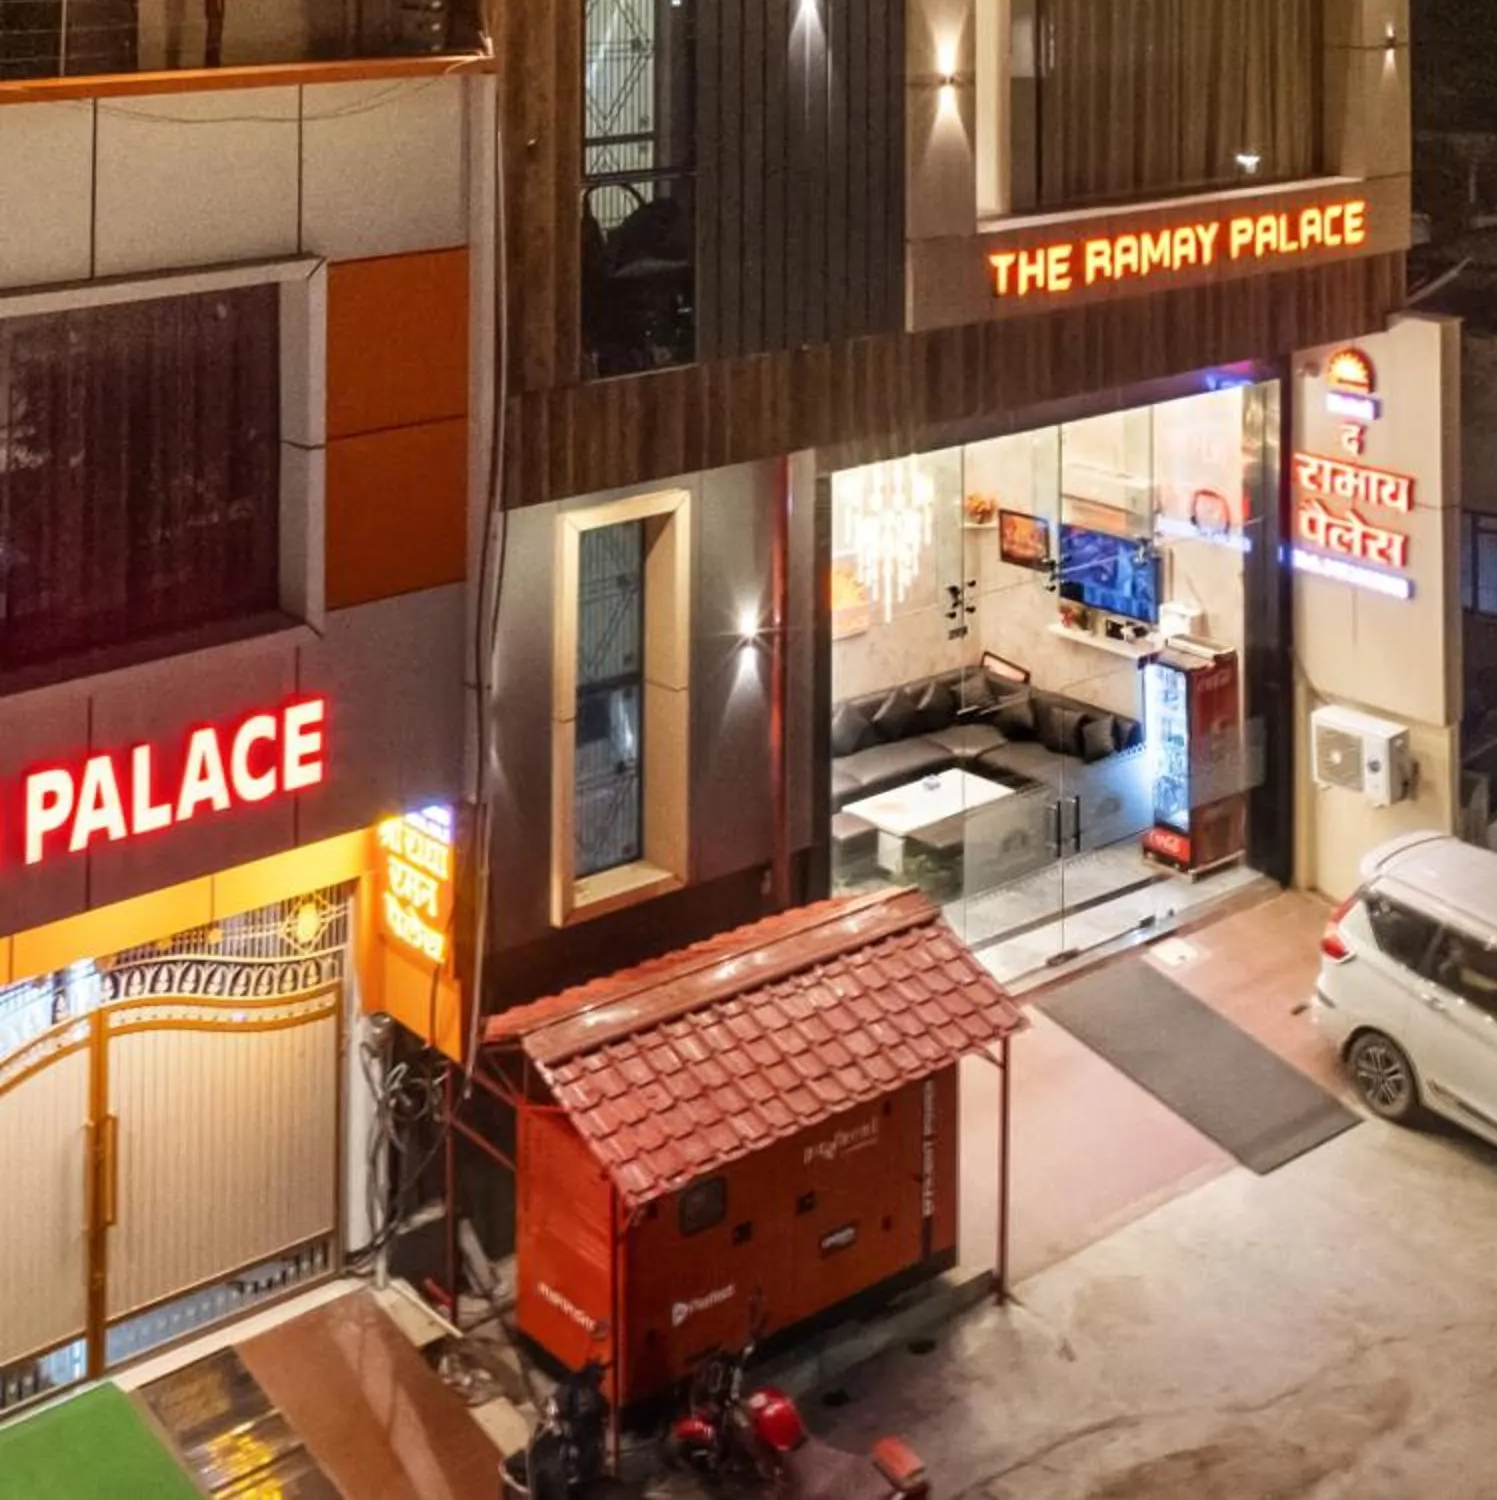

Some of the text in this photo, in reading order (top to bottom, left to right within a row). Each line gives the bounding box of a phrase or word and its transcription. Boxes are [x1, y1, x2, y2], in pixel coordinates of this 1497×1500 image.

[988, 200, 1366, 296] THE RAMAY PALACE
[1340, 421, 1366, 457] द
[1294, 453, 1412, 513] रामाय
[25, 699, 325, 866] PALACE
